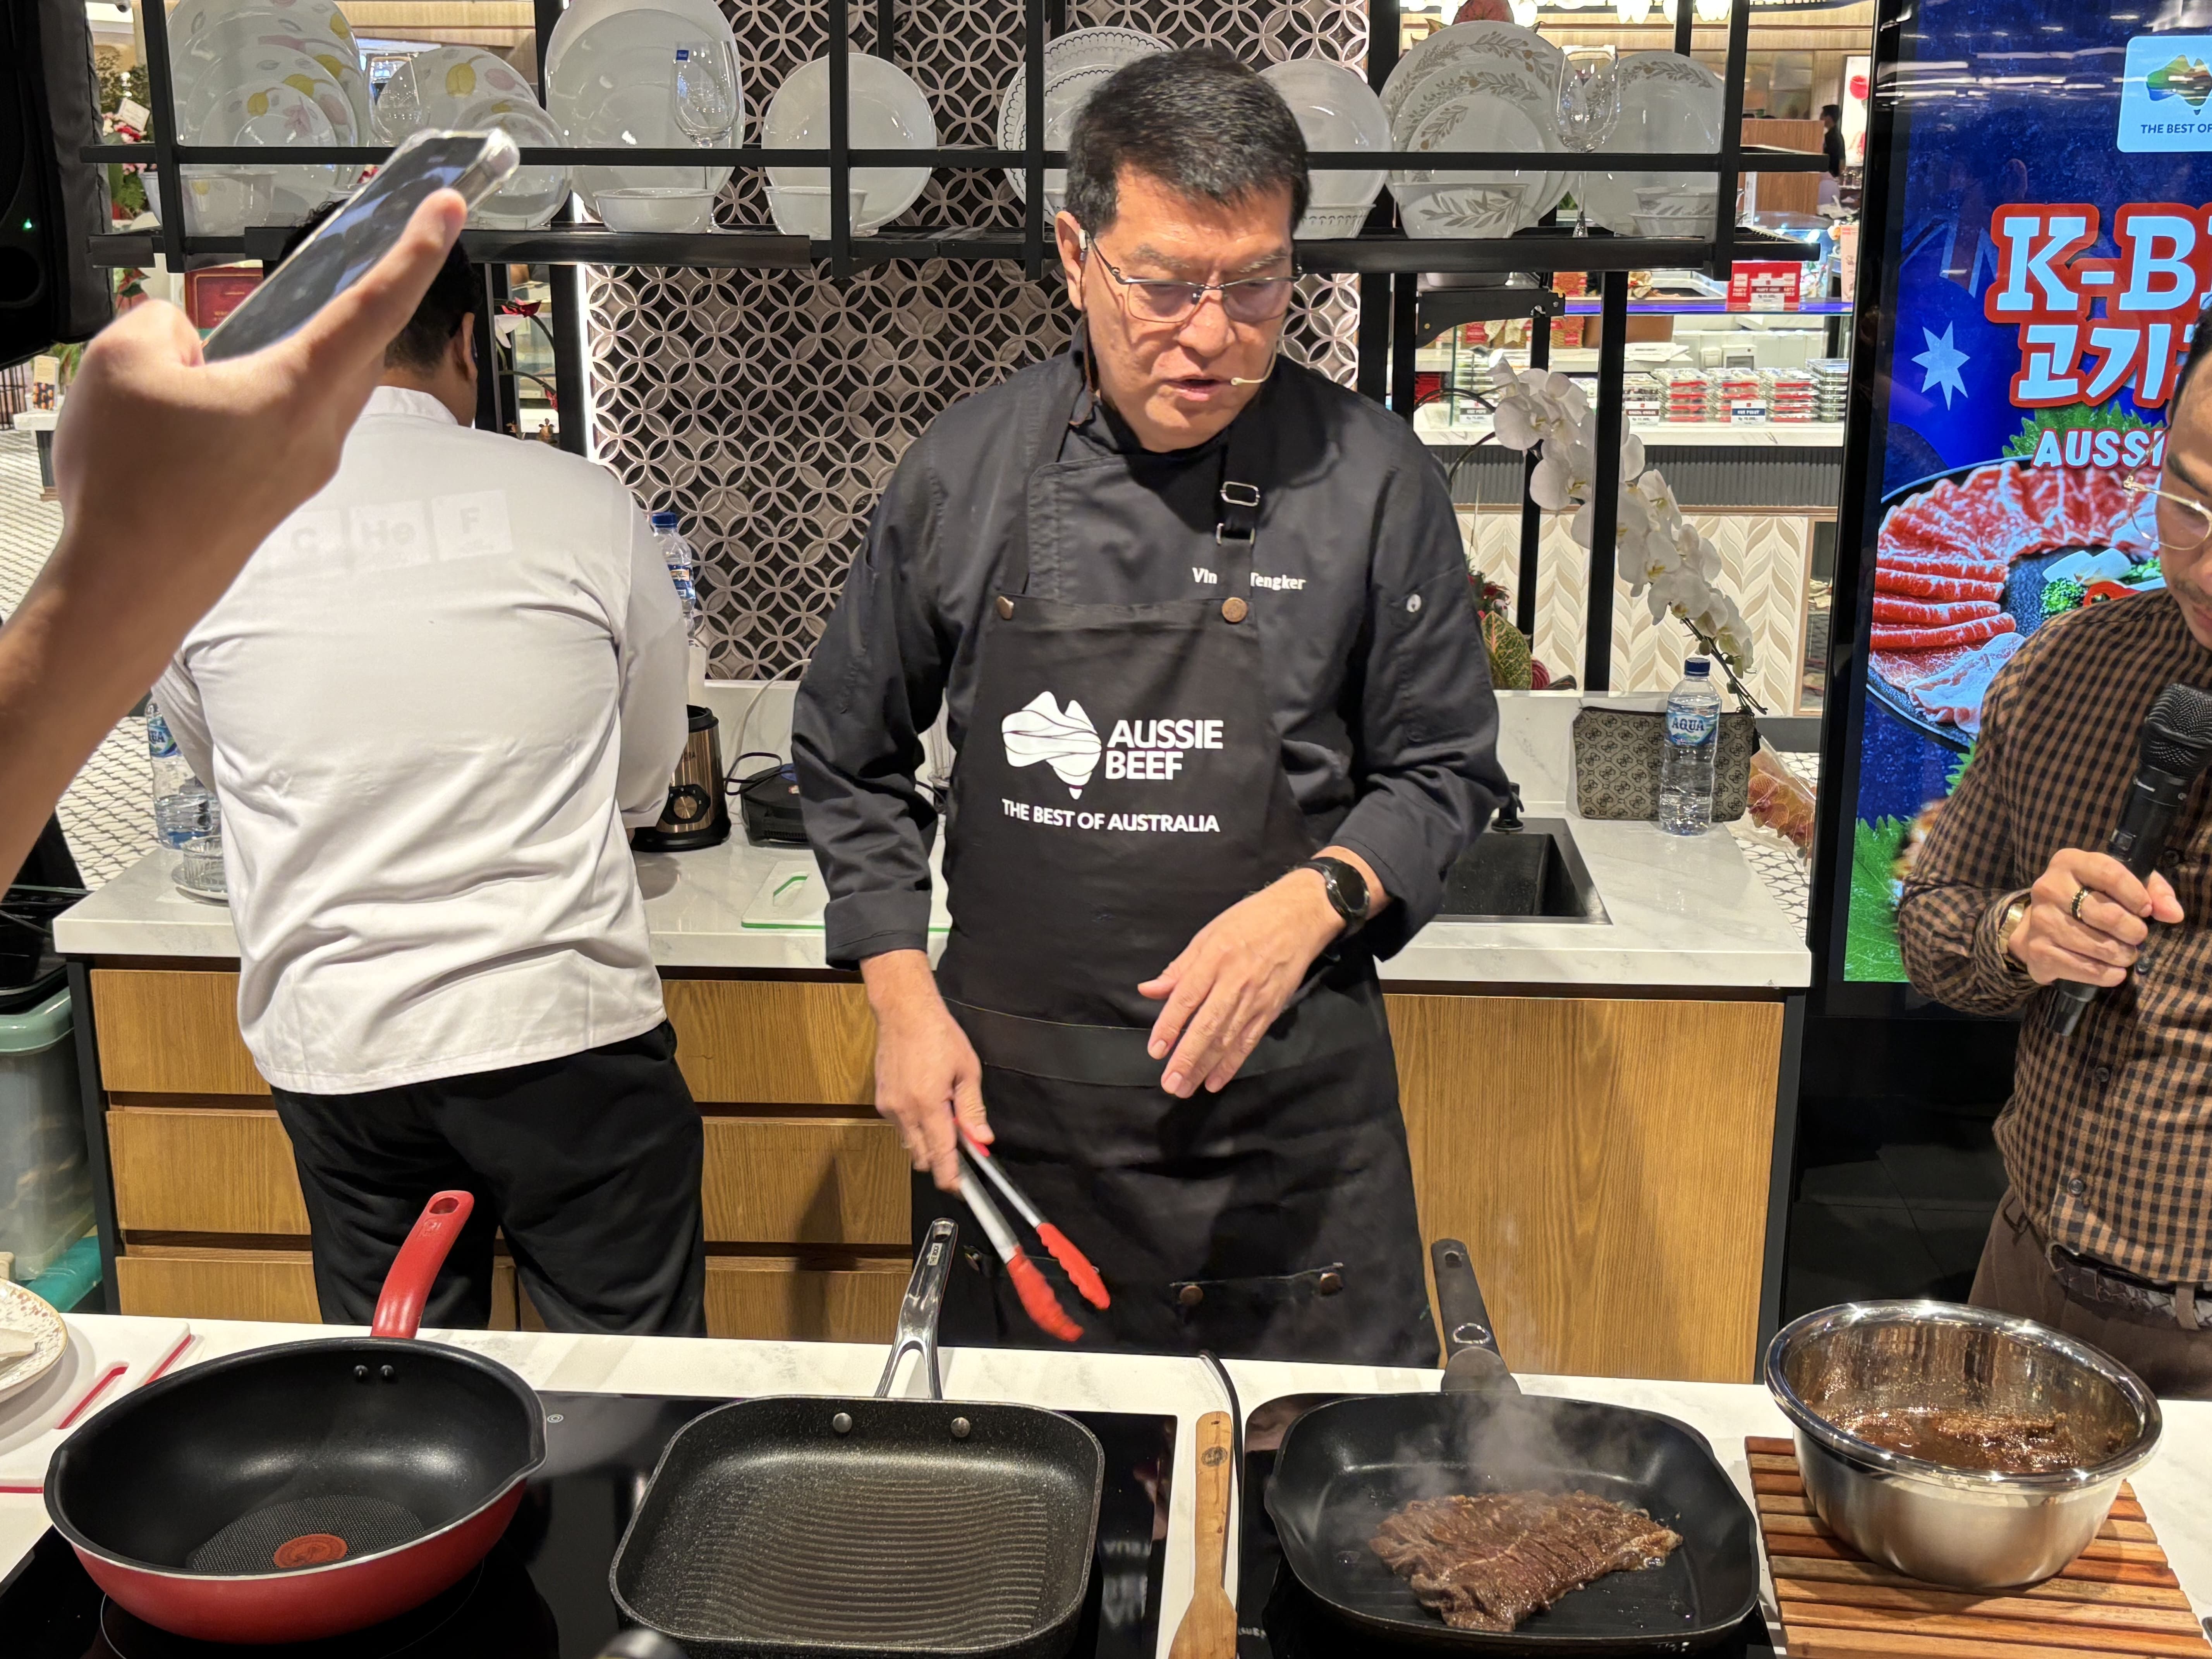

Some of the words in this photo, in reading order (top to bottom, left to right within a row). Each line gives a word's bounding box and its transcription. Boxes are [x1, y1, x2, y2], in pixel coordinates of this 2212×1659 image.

[2141, 124, 2164, 134] THE
[2166, 123, 2195, 134] BEST
[1997, 215, 2212, 311] K-B
[2018, 323, 2195, 400] 고기
[1106, 719, 1224, 750] AUSSIE
[1671, 717, 1705, 733] AQUA
[1105, 751, 1183, 780] BEEF
[1001, 798, 1030, 821] THE
[1033, 805, 1075, 827] BEST
[1077, 812, 1106, 830] OF
[1107, 814, 1221, 832] AUSTRALIA
